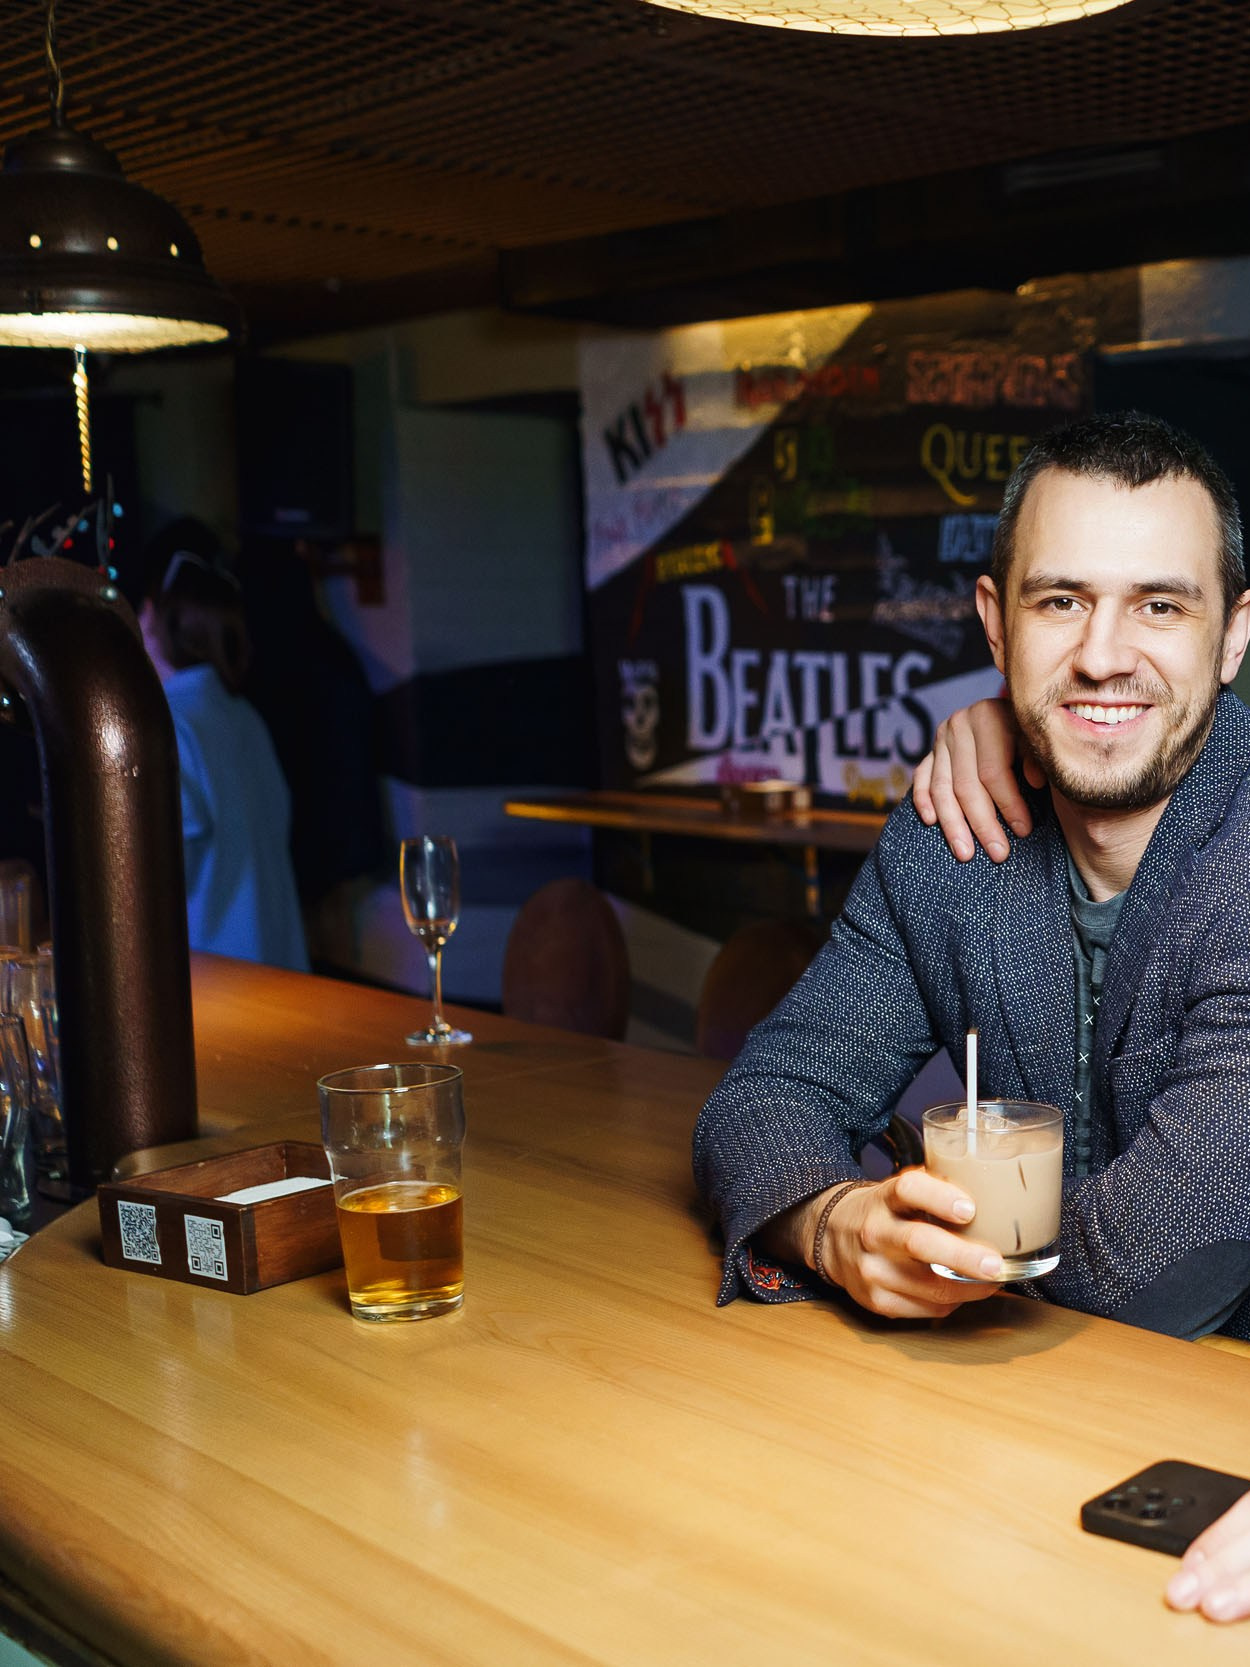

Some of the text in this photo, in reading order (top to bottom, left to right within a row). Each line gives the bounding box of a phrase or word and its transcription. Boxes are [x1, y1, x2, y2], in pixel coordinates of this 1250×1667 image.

[604, 369, 686, 484] KISS
[920, 423, 1034, 505] QUEE
[782, 574, 838, 622] THE
[681, 584, 935, 787] BEATLES
